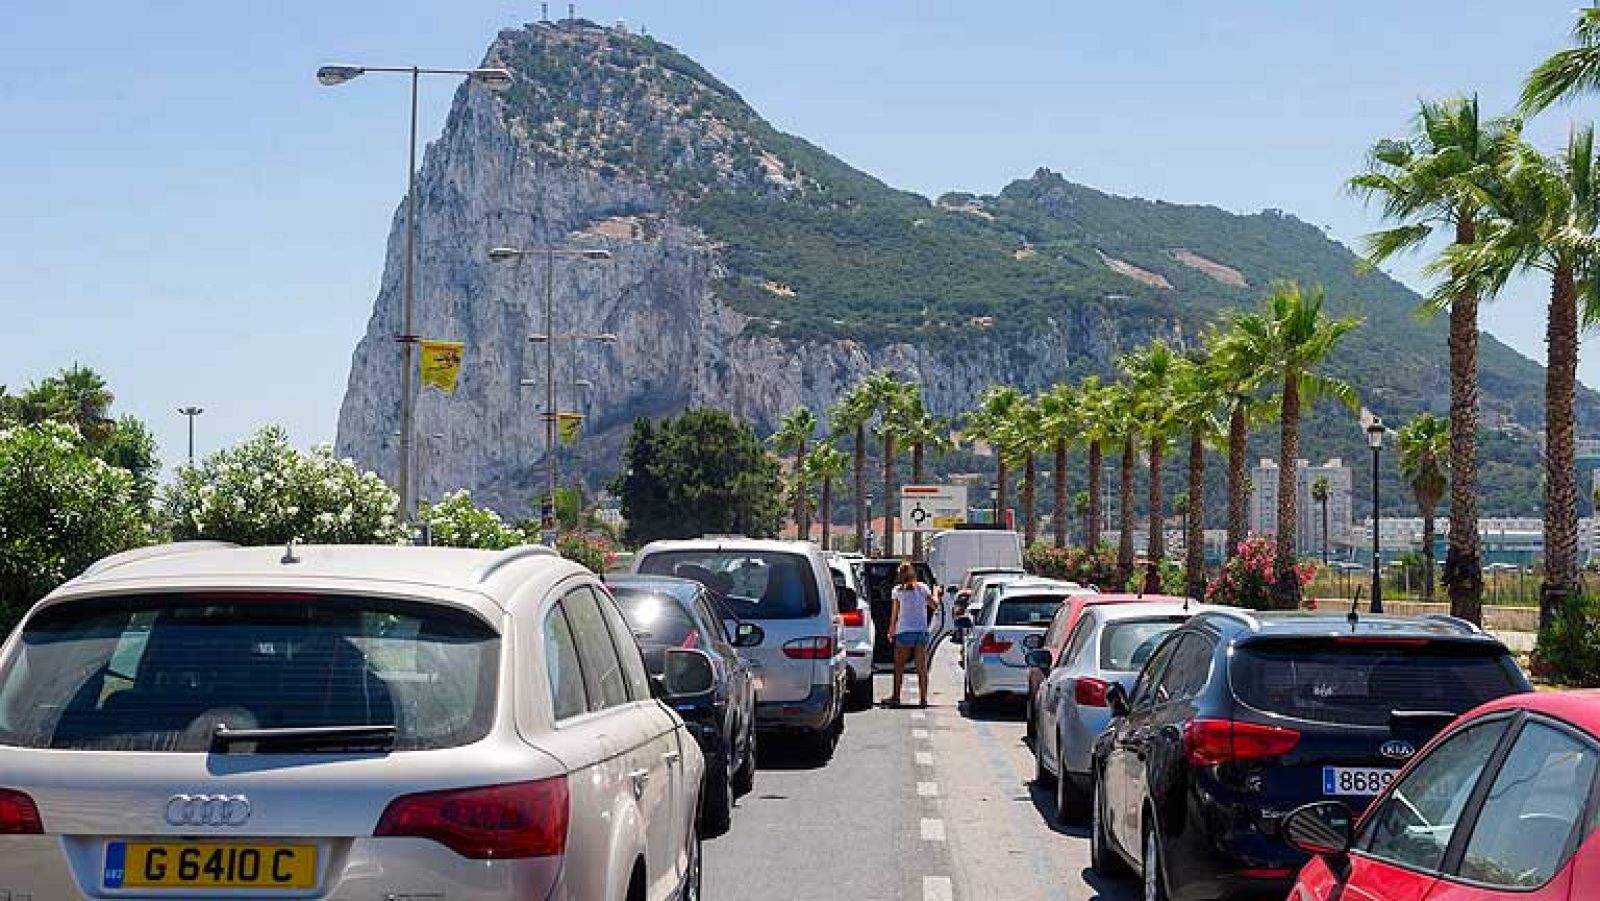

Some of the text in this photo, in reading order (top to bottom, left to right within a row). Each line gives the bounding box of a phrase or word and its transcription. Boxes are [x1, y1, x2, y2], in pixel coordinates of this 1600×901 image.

[1387, 744, 1409, 754] KIA
[145, 848, 295, 882] G 6410 C
